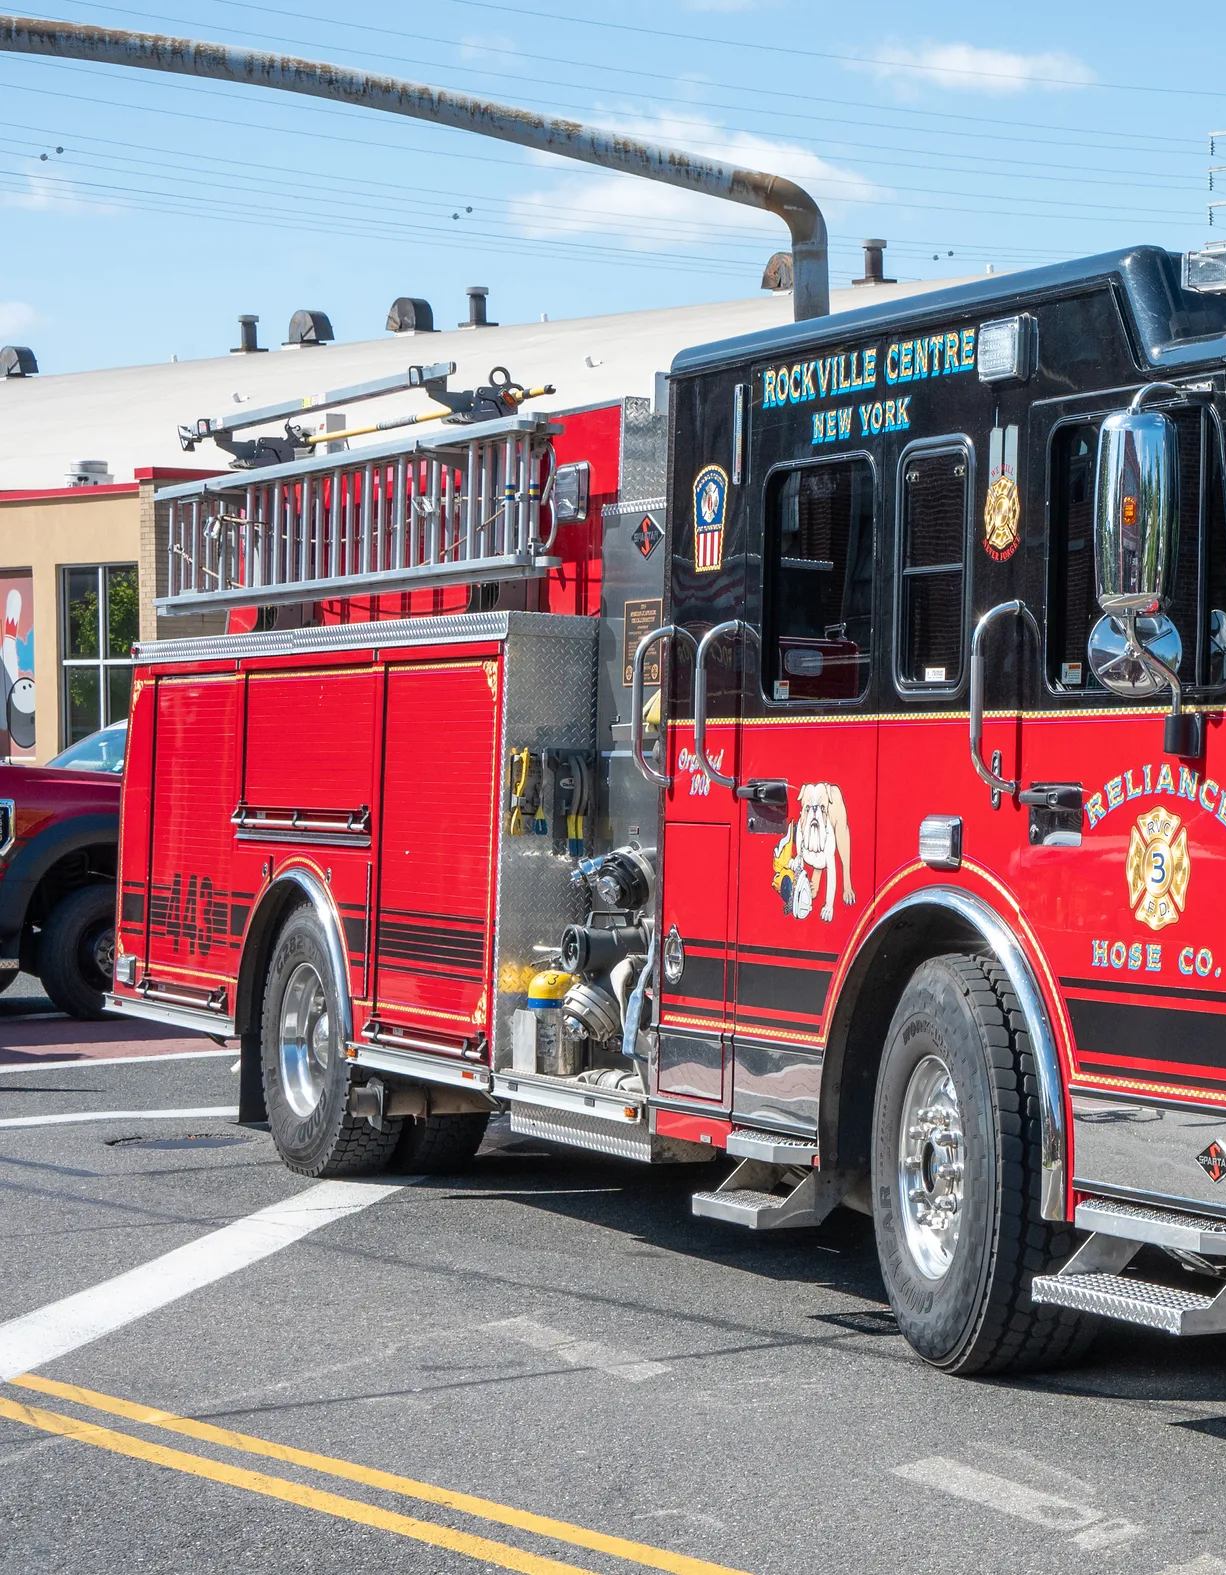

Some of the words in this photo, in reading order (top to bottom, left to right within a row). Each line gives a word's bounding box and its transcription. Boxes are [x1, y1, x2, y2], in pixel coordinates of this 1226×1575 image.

[762, 348, 877, 409] ROCKVILLE
[884, 328, 976, 386] CENTRE
[811, 405, 853, 445] NEW
[858, 396, 912, 436] YORK
[991, 466, 999, 478] WE
[1001, 463, 1015, 477] WILL
[983, 537, 999, 561] NEVER
[1000, 532, 1021, 561] FORGET
[689, 773, 711, 796] 1908
[1147, 819, 1172, 837] RVC
[1151, 852, 1166, 884] 3
[166, 873, 213, 957] 443
[1091, 939, 1162, 972] HOSE
[1178, 947, 1222, 978] CO.
